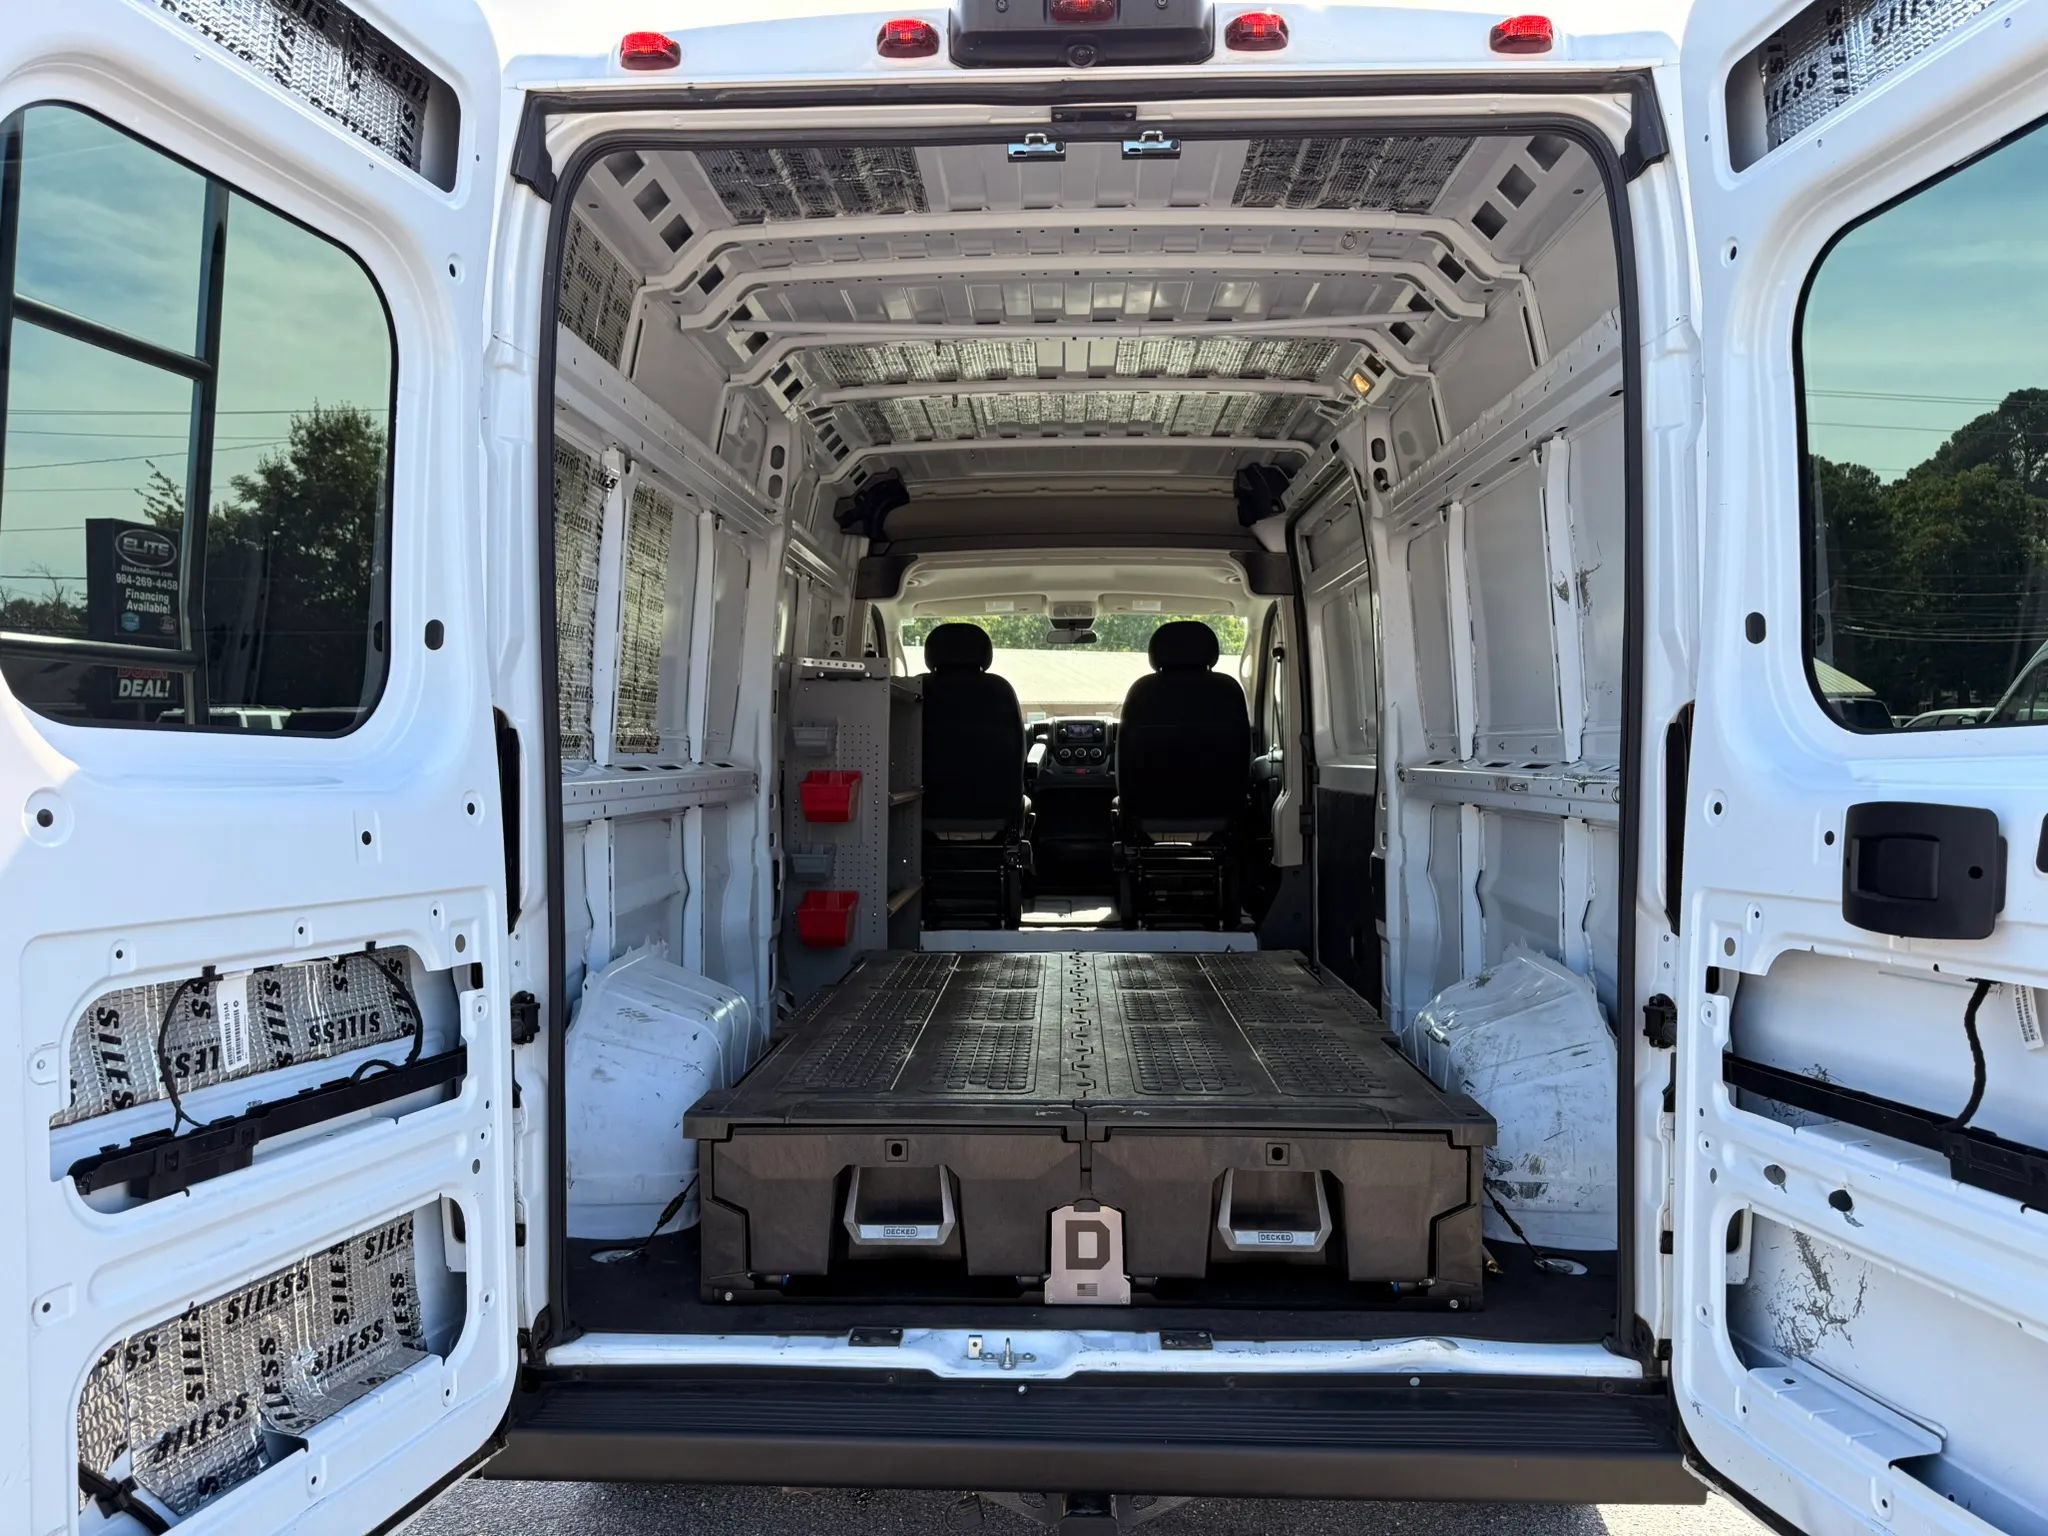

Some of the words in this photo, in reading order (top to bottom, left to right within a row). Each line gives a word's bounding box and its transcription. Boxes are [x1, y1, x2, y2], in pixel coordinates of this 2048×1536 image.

[123, 538, 169, 556] ELITE
[125, 588, 169, 603] Financing
[126, 600, 171, 614] Available!
[119, 679, 171, 698] DEAL!
[309, 1011, 381, 1048] SILESS
[885, 1227, 917, 1236] DECKED
[1259, 1233, 1292, 1242] DECKED
[1065, 1220, 1111, 1270] D
